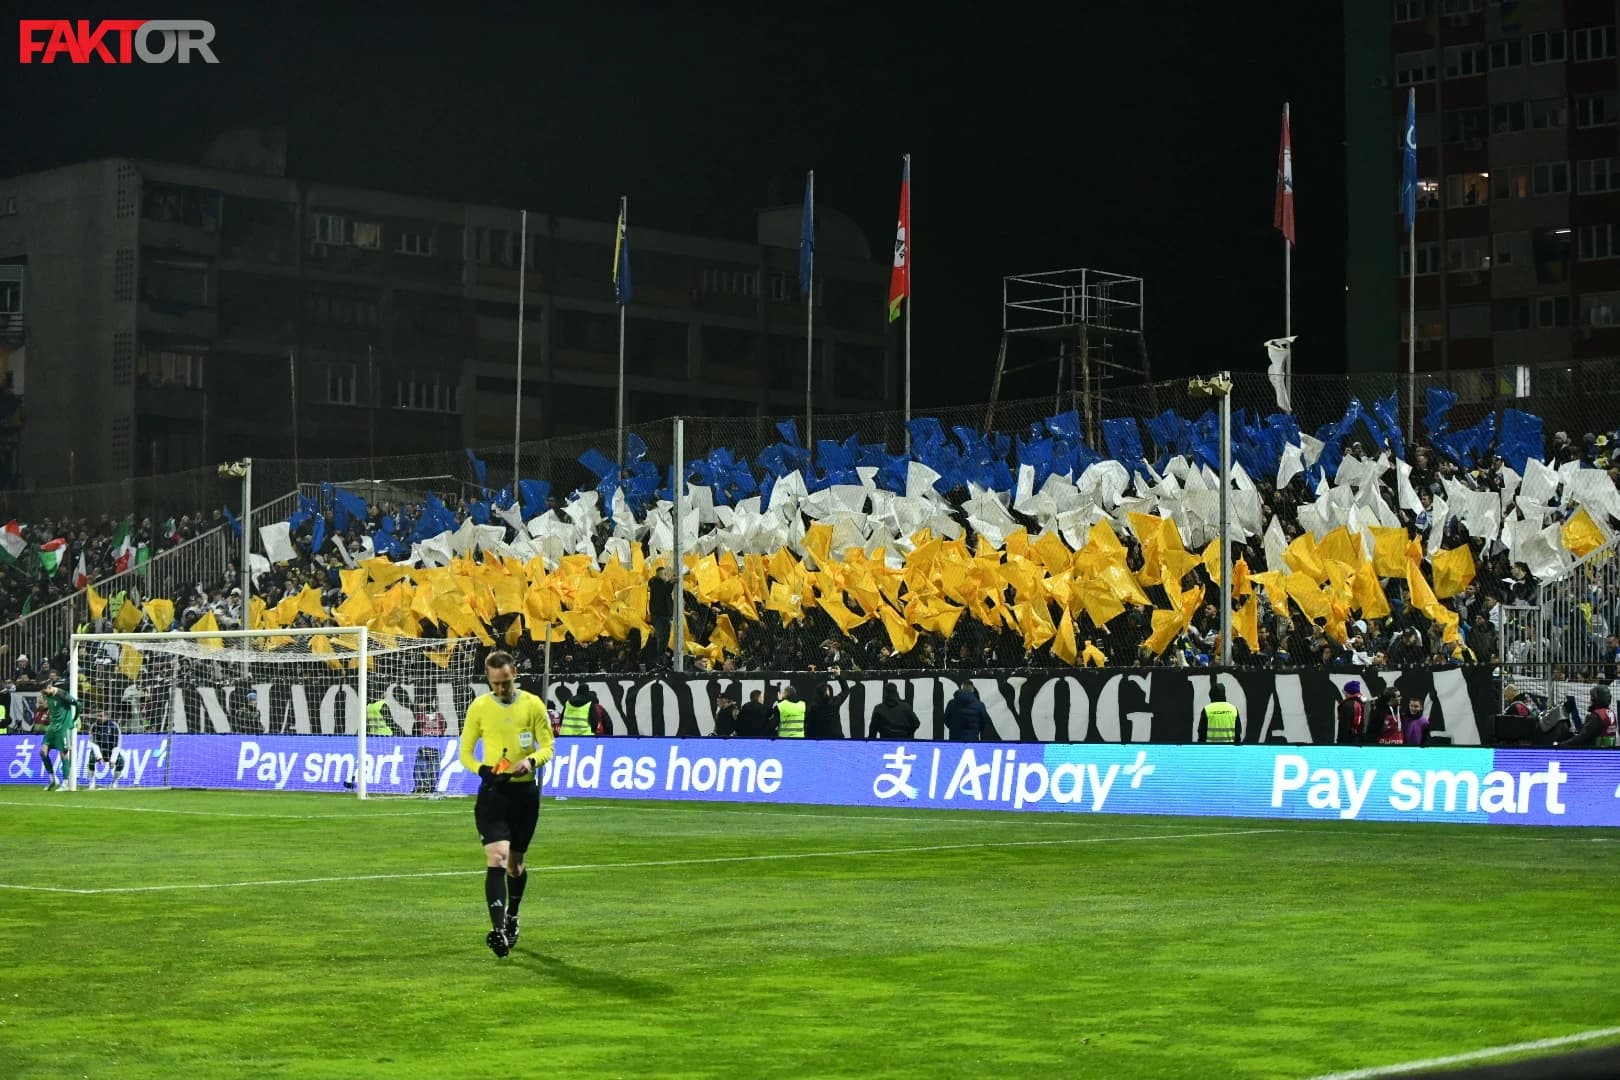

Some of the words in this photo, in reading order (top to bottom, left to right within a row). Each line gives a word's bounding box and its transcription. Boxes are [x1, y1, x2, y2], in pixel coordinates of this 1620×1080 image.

[237, 741, 298, 790] Pay
[303, 745, 404, 785] smart
[536, 745, 603, 791] orld
[611, 755, 657, 791] as
[667, 745, 783, 794] home
[1272, 755, 1377, 820] Pay
[1389, 760, 1568, 816] smart
